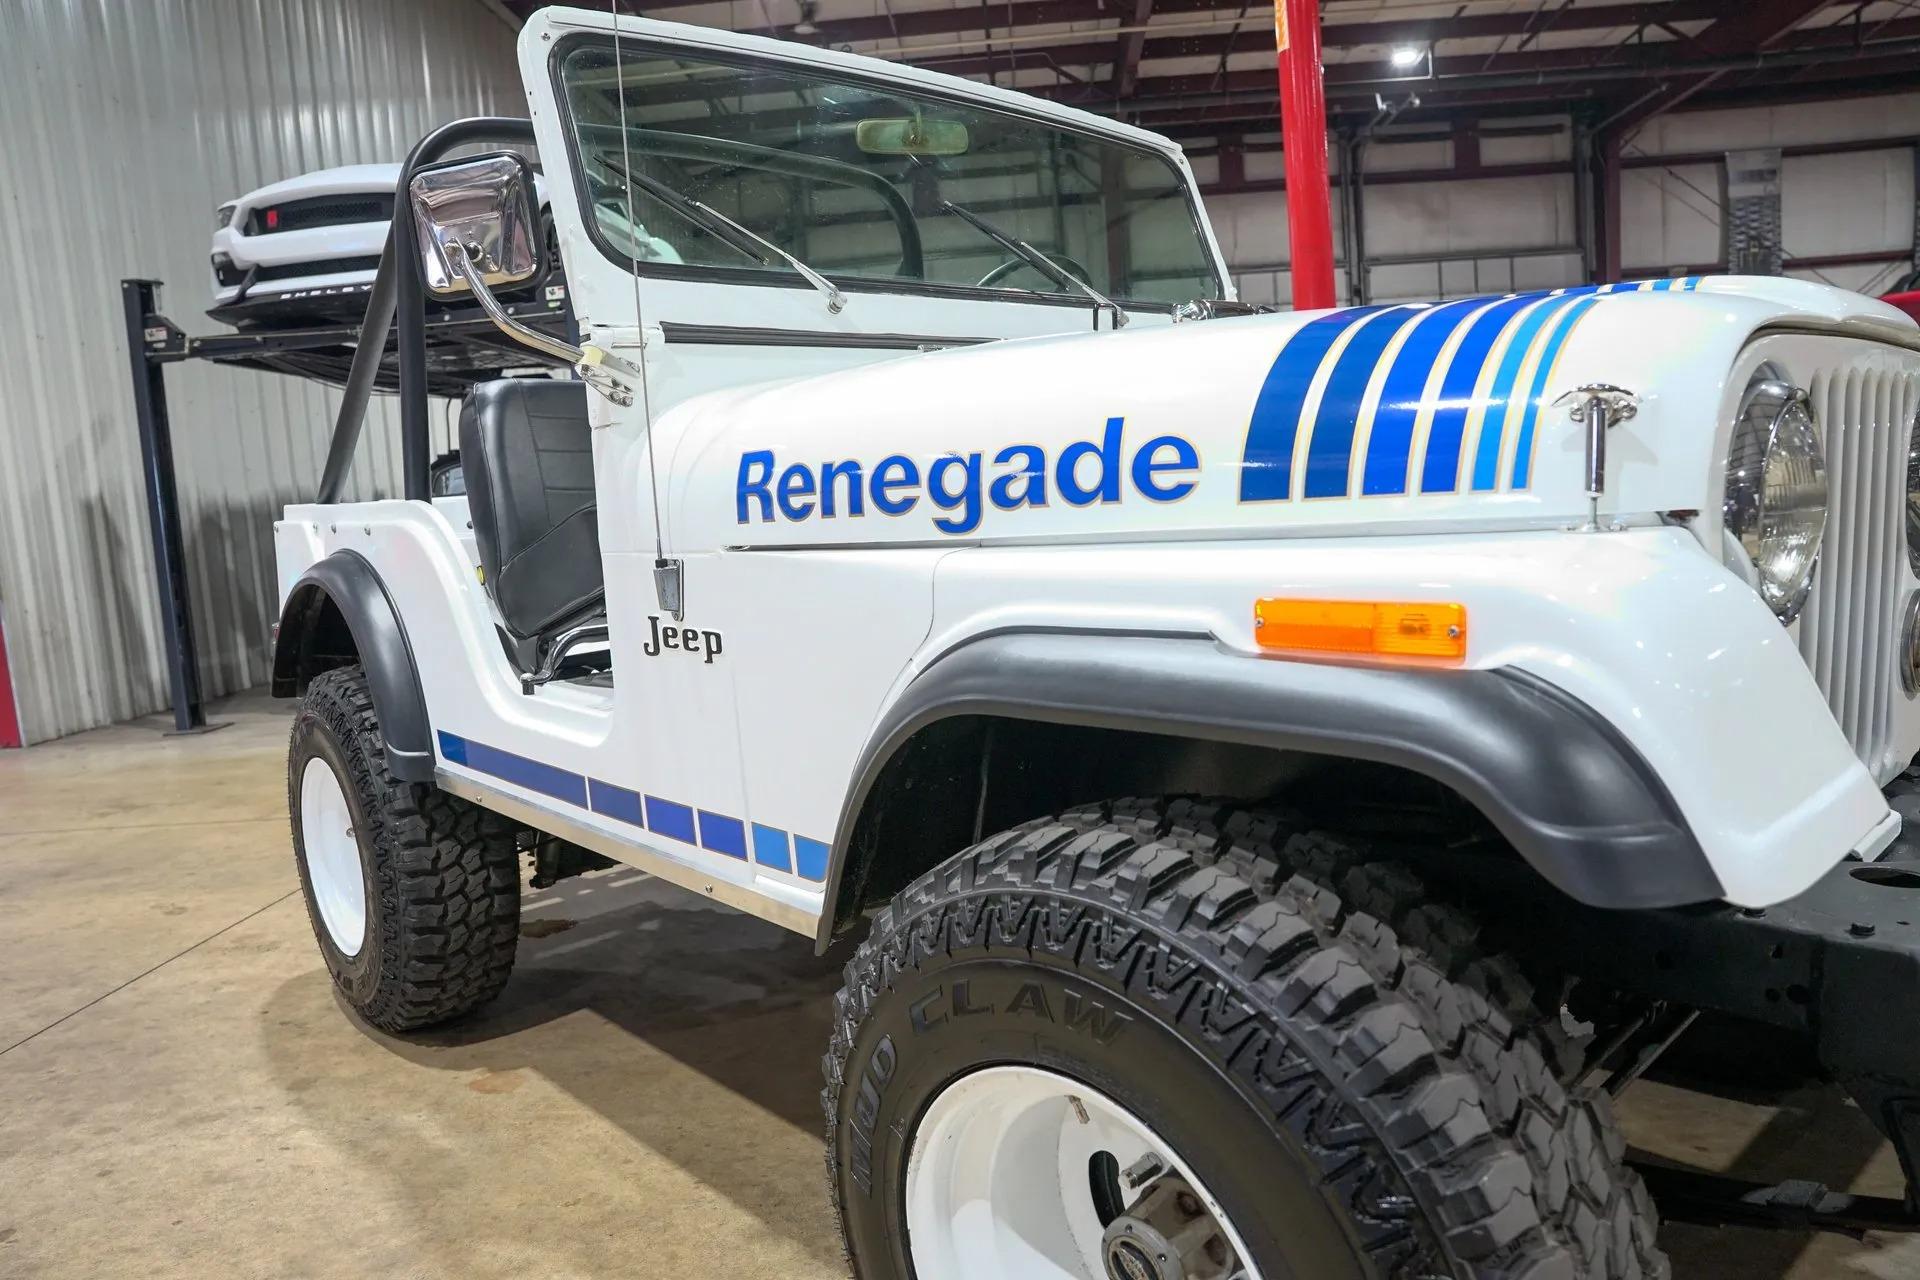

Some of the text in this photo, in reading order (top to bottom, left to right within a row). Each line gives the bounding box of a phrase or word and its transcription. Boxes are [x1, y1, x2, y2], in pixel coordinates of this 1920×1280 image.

[736, 417, 1202, 536] Renegade
[644, 615, 723, 664] Jeep
[850, 979, 1134, 1198] MUD CLAW
